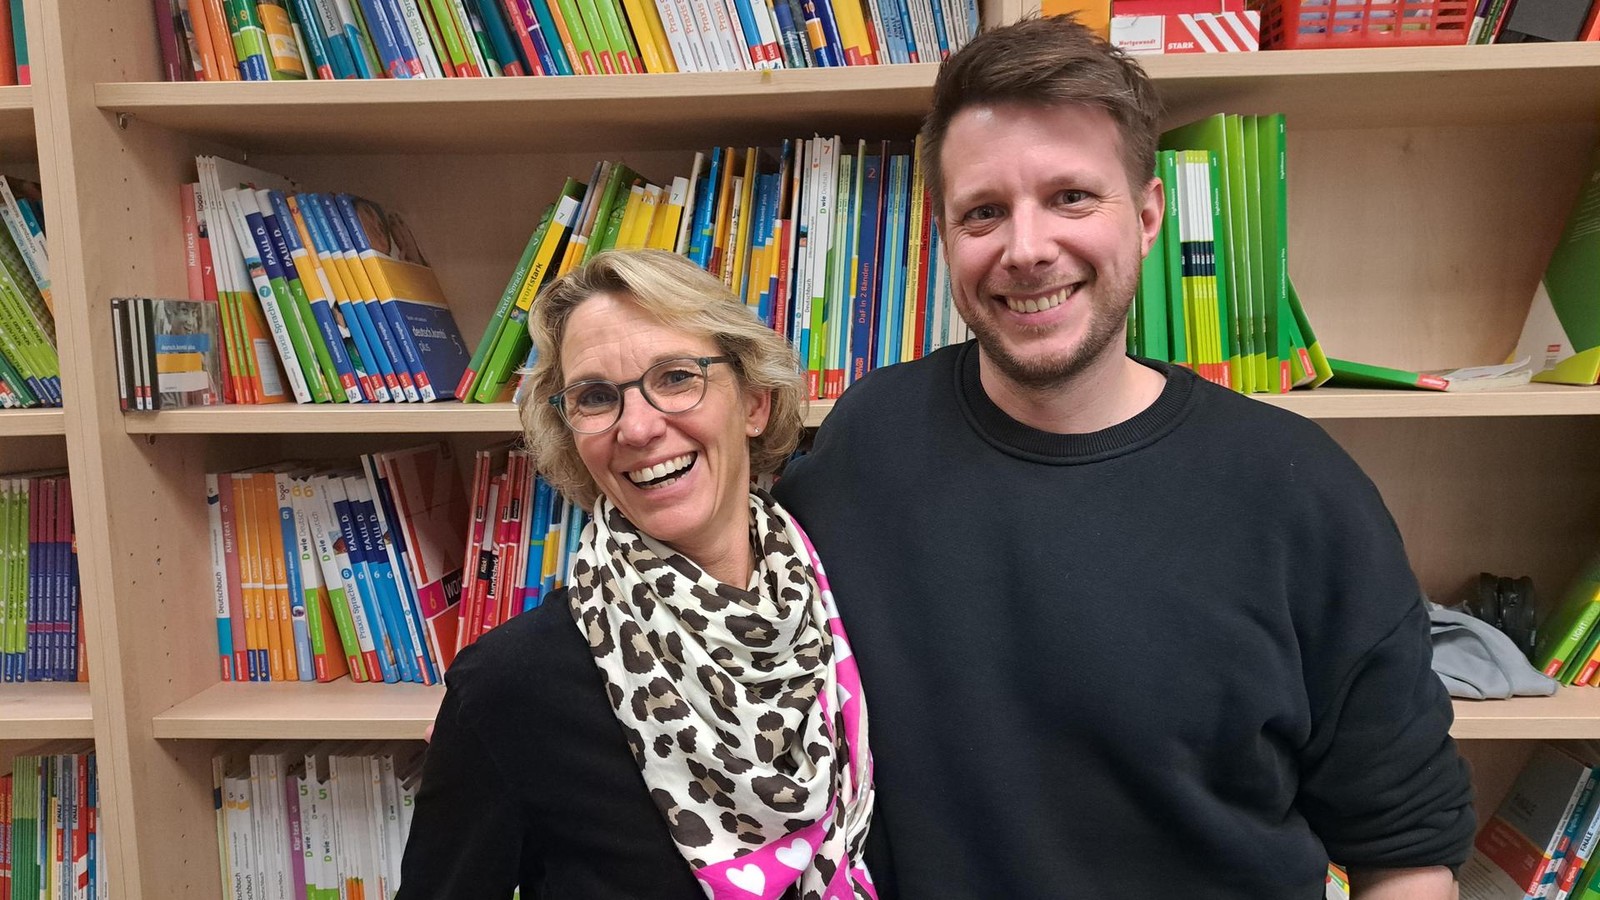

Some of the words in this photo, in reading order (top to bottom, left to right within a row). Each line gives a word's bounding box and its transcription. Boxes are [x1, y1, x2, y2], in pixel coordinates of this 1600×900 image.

[240, 10, 247, 20] 8
[662, 3, 678, 33] Praxis
[678, 3, 694, 33] Praxis
[696, 2, 711, 32] Praxis
[712, 1, 728, 32] Praxis
[409, 18, 426, 46] Praxis
[753, 45, 763, 60] Klett
[766, 44, 776, 59] Klett
[824, 146, 830, 154] 7
[867, 167, 876, 179] 2
[16, 219, 38, 254] Schnittpunkt
[204, 264, 212, 274] 7
[516, 261, 546, 303] wortstark
[496, 294, 512, 317] Praxis
[507, 265, 527, 295] Sprache
[802, 278, 813, 312] Deutschbuch
[264, 300, 284, 334] Sprache
[276, 333, 292, 360] Praxis
[276, 481, 290, 500] logo!
[293, 486, 302, 497] 6
[304, 486, 313, 497] 6
[281, 510, 290, 519] 6
[296, 509, 306, 536] Deutsch
[310, 511, 323, 538] Deutsch
[318, 539, 326, 553] wie
[321, 553, 330, 561] D
[343, 569, 350, 578] 6
[358, 572, 365, 580] 6
[374, 571, 380, 579] 6
[387, 571, 394, 579] 6
[215, 571, 224, 613] Deutschbuch
[343, 582, 362, 614] Sprache
[430, 592, 436, 609] 6
[352, 614, 367, 639] Praxis
[300, 785, 309, 797] 5
[318, 788, 328, 800] 5
[404, 794, 413, 807] 5
[1565, 865, 1578, 883] Englisch
